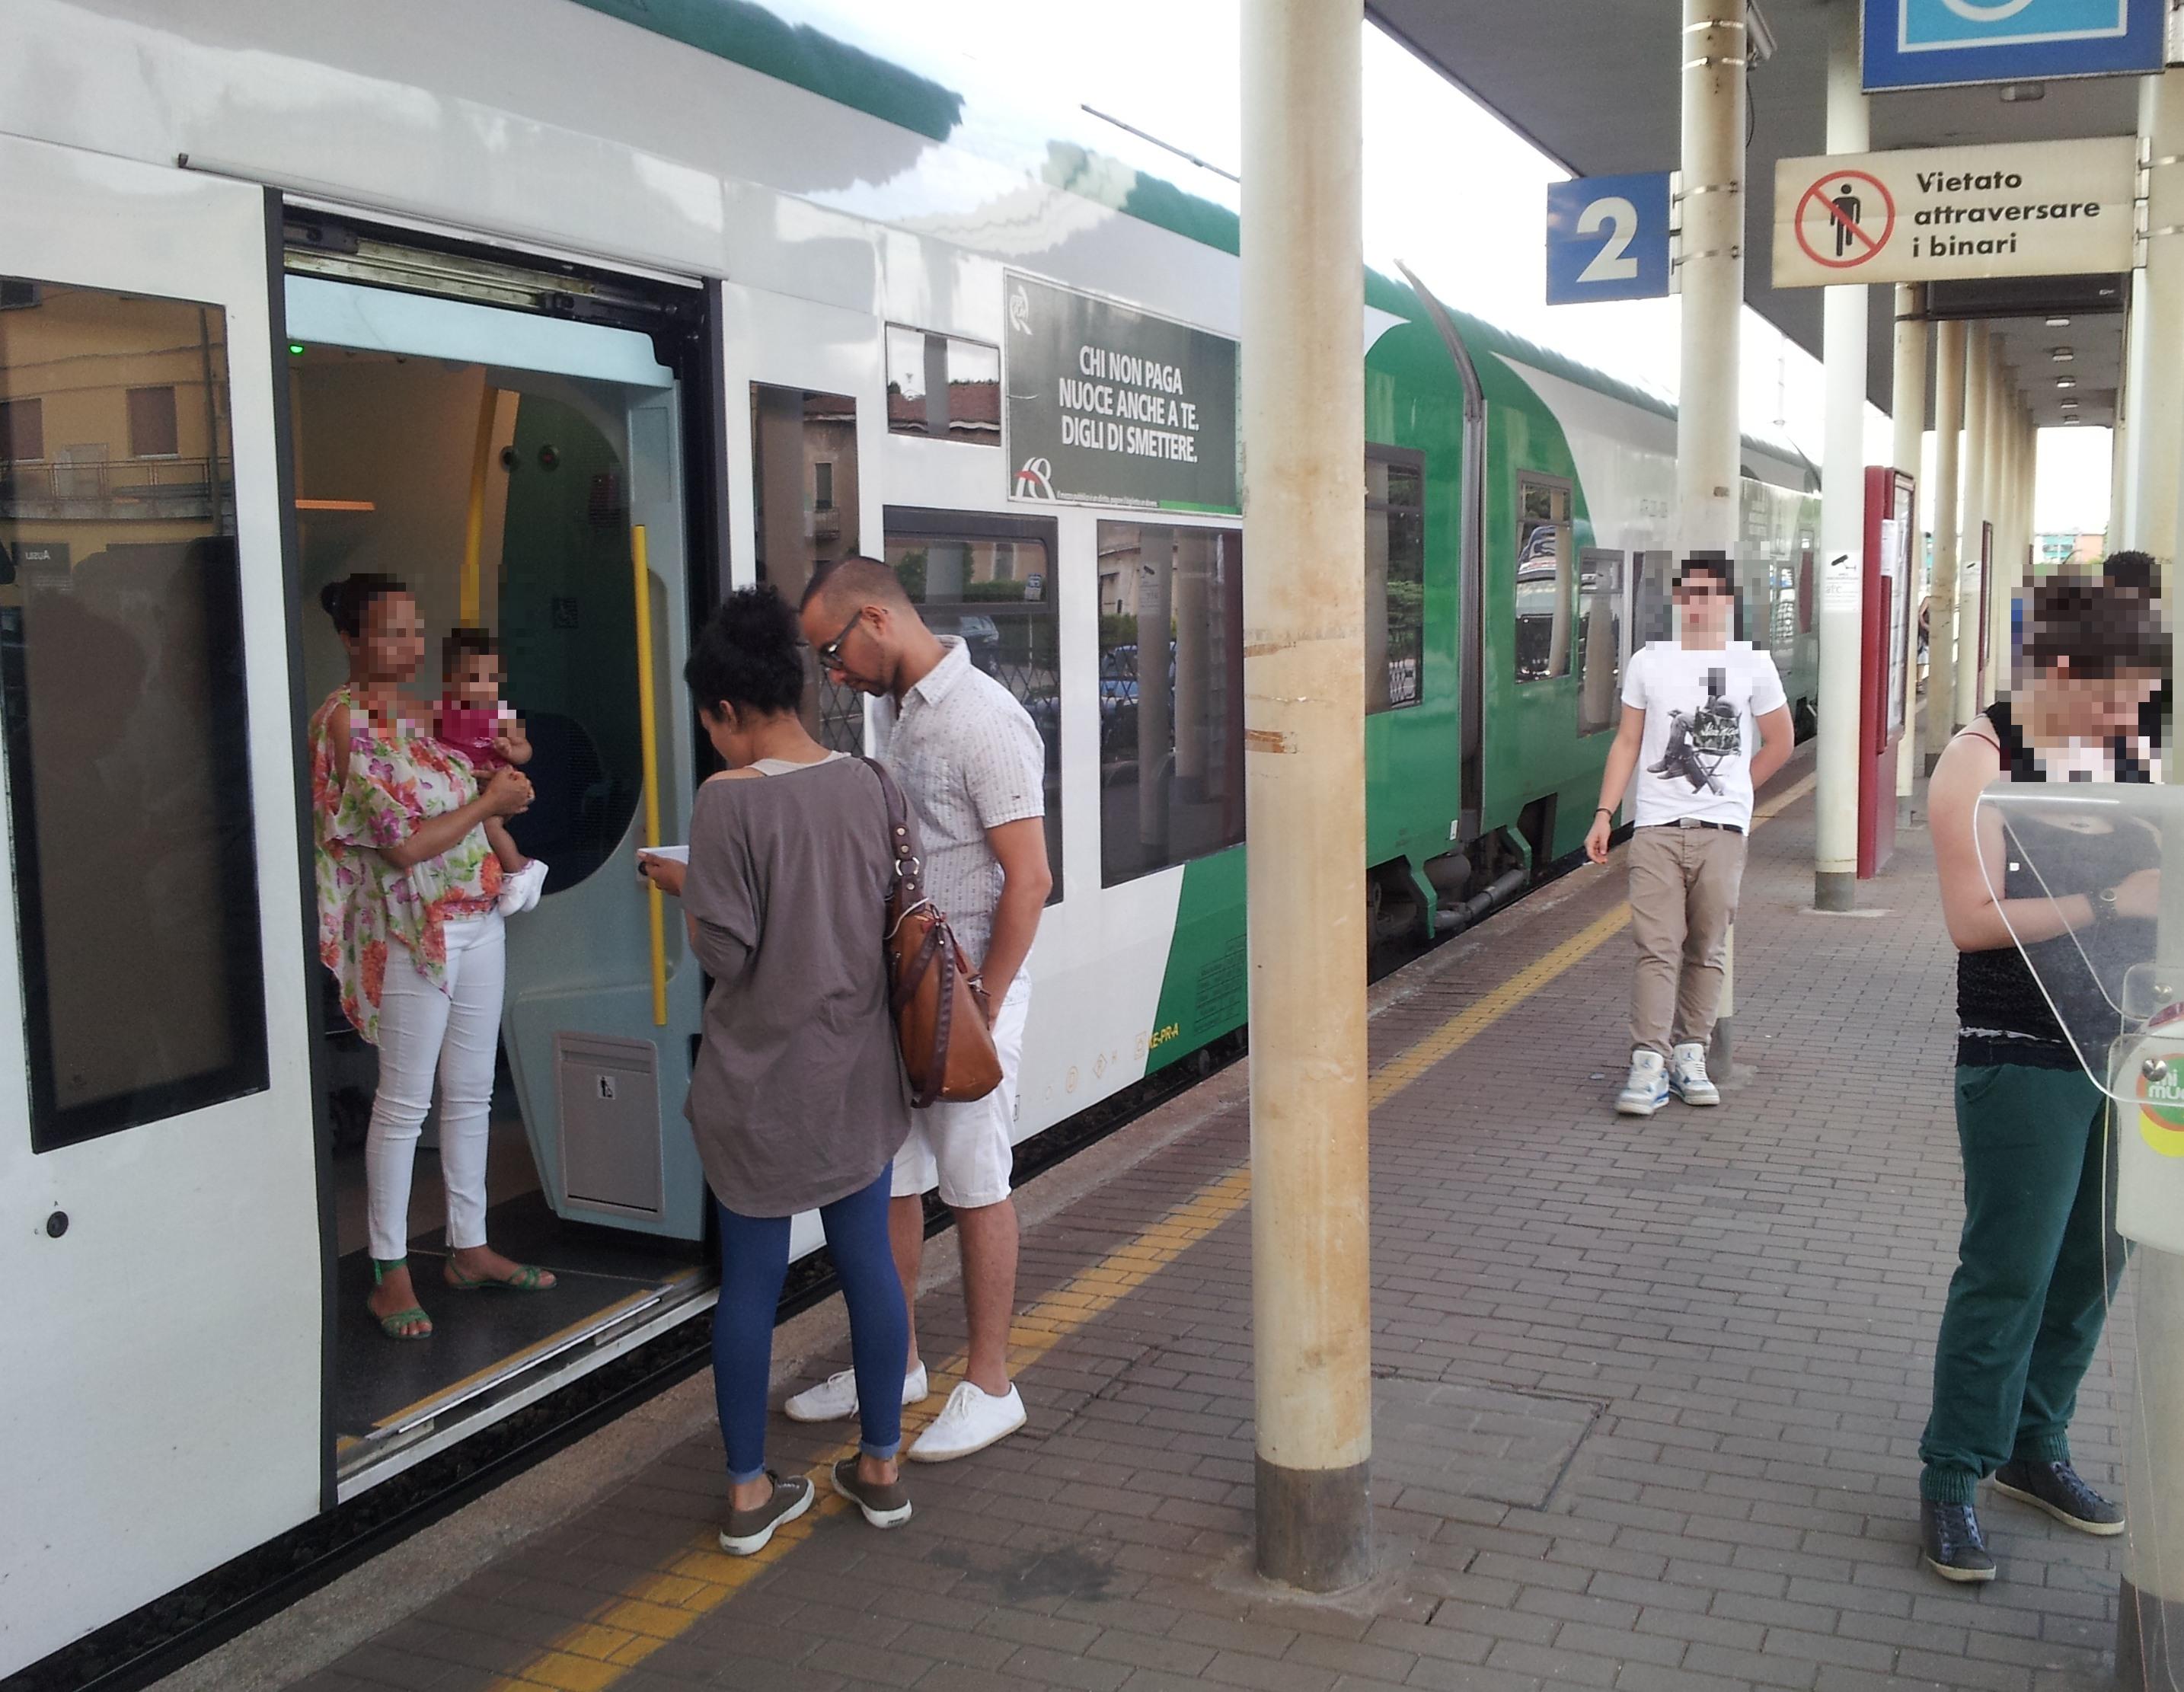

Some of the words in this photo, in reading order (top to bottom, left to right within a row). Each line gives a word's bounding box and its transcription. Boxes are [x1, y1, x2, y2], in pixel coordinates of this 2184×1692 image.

[1917, 171, 2023, 193] Vietato
[1914, 202, 2101, 225] attraversare
[1576, 196, 1637, 283] 2
[1913, 237, 1919, 257] i
[1930, 232, 2016, 257] binari
[1079, 345, 1105, 378] CHI
[1109, 353, 1142, 386] NON
[1145, 360, 1183, 395] PAGA
[1059, 377, 1114, 416] NUOCE
[1116, 389, 1165, 425] ANCHE
[1167, 400, 1179, 427] A
[1180, 403, 1199, 431] TE.
[1062, 414, 1104, 450] DIGLI
[1107, 422, 1124, 452] DI
[1126, 426, 1198, 463] SMETTERE.
